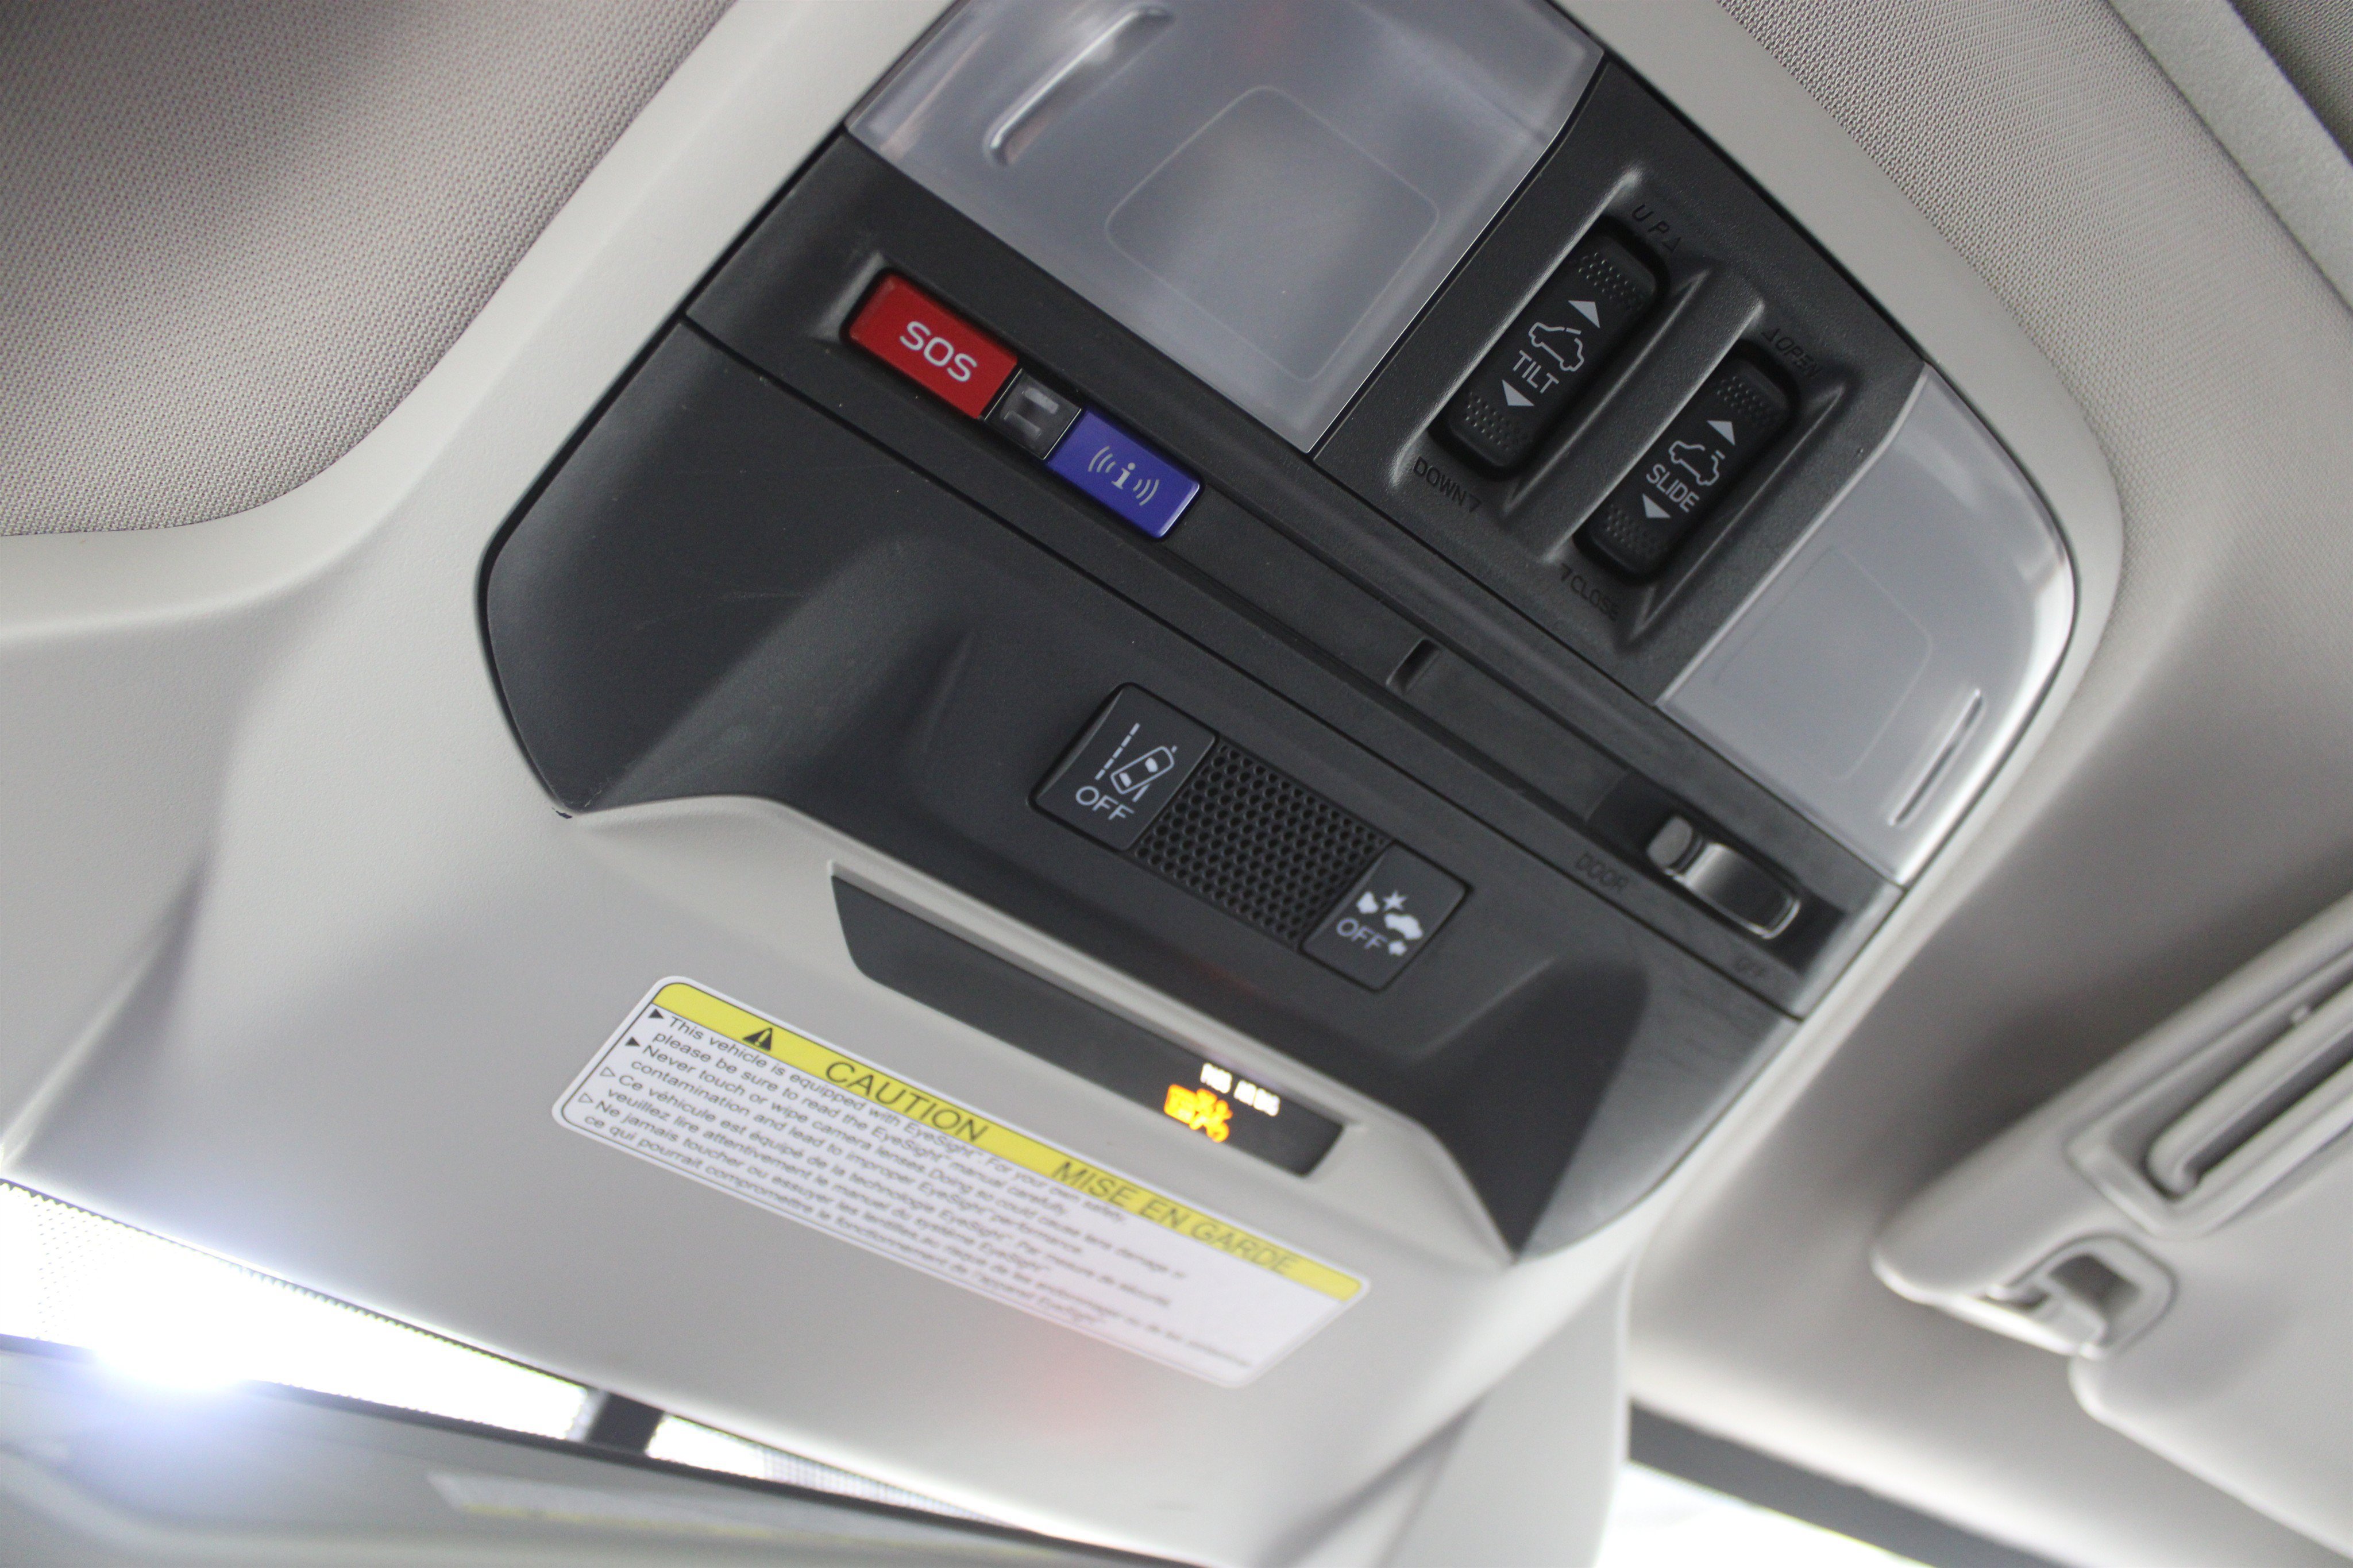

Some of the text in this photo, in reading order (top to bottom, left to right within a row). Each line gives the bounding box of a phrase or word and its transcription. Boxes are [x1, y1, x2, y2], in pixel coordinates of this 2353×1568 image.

[1632, 204, 1669, 233] UP
[900, 320, 977, 382] SOS
[1513, 349, 1560, 393] TILT
[1776, 337, 1822, 378] OPEN
[1413, 455, 1467, 507] DOWN
[1646, 463, 1700, 513] SLIDE
[1075, 785, 1135, 821] OFF
[1336, 918, 1388, 950] OFF
[642, 1044, 696, 1073] Never
[698, 1069, 746, 1096] touch
[748, 1093, 768, 1104] or
[770, 1102, 809, 1123] wipe
[811, 1121, 873, 1150] camera
[651, 1032, 712, 1062] please
[715, 1057, 738, 1073] be
[740, 1071, 779, 1091] sure
[781, 1087, 799, 1100] to
[801, 1097, 841, 1118] read
[842, 1113, 868, 1130] the
[669, 1017, 704, 1040] This
[709, 1037, 767, 1068] vehicle
[770, 1063, 786, 1076] is
[789, 1073, 866, 1111] equipped
[868, 1107, 901, 1126] with
[584, 1115, 605, 1128] ce
[608, 1126, 637, 1141] qui
[607, 1088, 671, 1121] veuillez
[673, 1115, 700, 1133] lire
[618, 1074, 643, 1091] Ce
[648, 1087, 716, 1122] véhicule
[719, 1119, 747, 1135] est
[630, 1060, 750, 1116] contamination
[753, 1114, 788, 1131] and
[788, 1126, 826, 1148] lead
[824, 1061, 988, 1142] CAUTION
[595, 1100, 620, 1117] Ne
[620, 1113, 679, 1142] jamais
[682, 1137, 745, 1167] toucher
[1052, 1161, 1297, 1275] MISE EN GARDE
